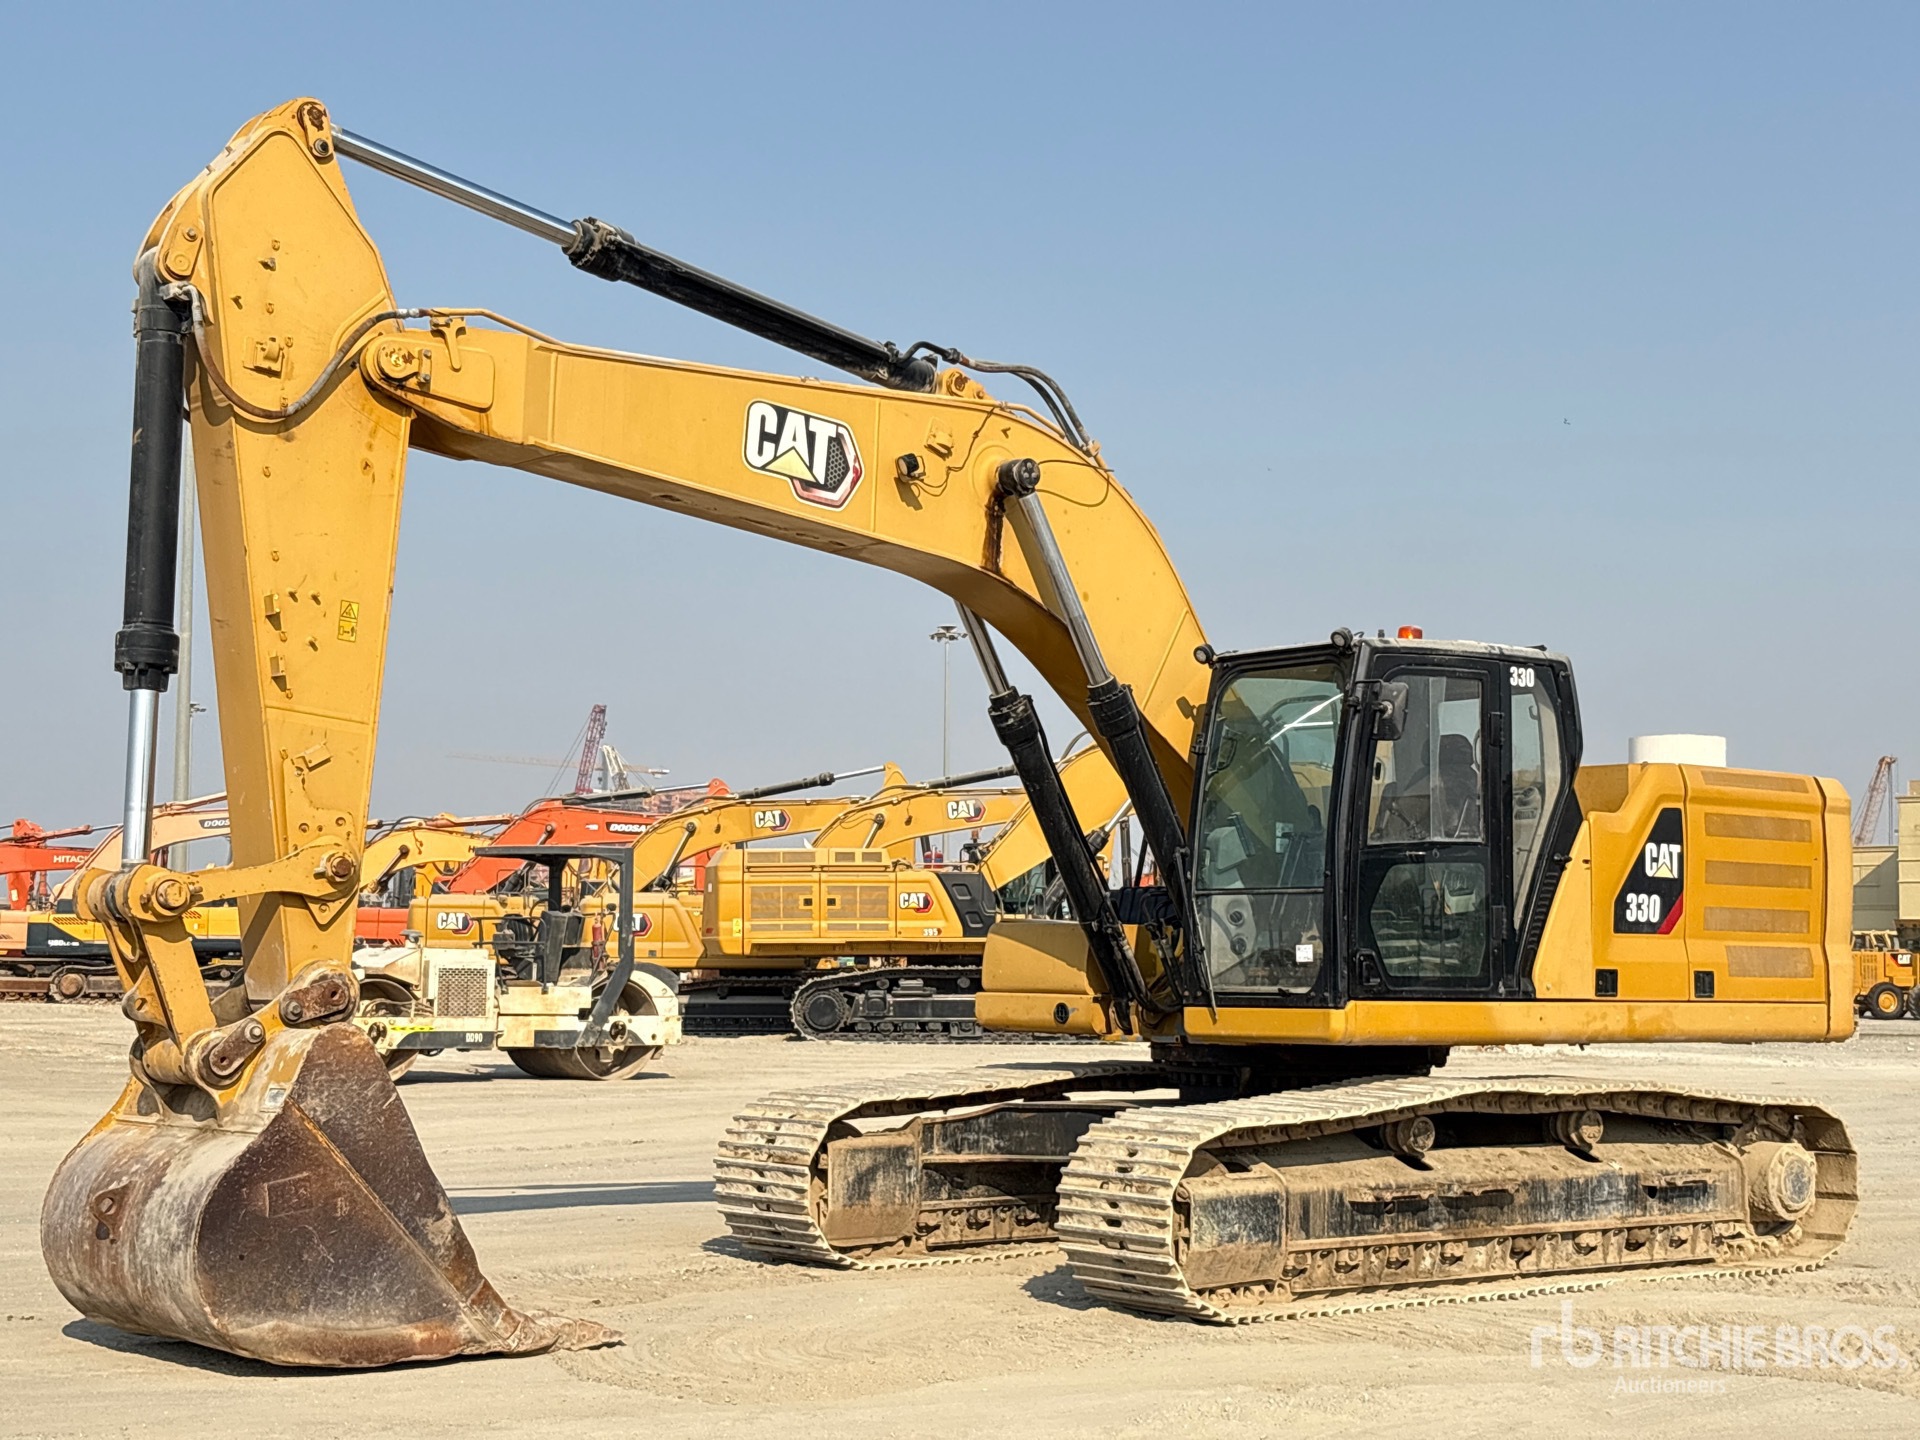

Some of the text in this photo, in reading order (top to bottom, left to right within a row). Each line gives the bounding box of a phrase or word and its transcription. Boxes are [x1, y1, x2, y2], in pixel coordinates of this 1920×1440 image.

[745, 401, 838, 485] CAT
[1510, 667, 1535, 688] 330
[947, 800, 975, 819] CAT
[609, 823, 650, 832] DOOSA
[754, 810, 782, 828] CAT
[53, 855, 88, 864] HITAC
[1645, 842, 1681, 878] CAT
[899, 893, 926, 909] CAT
[1626, 893, 1661, 923] 330
[437, 912, 466, 930] CAT
[923, 928, 938, 937] 395
[1897, 954, 1911, 965] CAT
